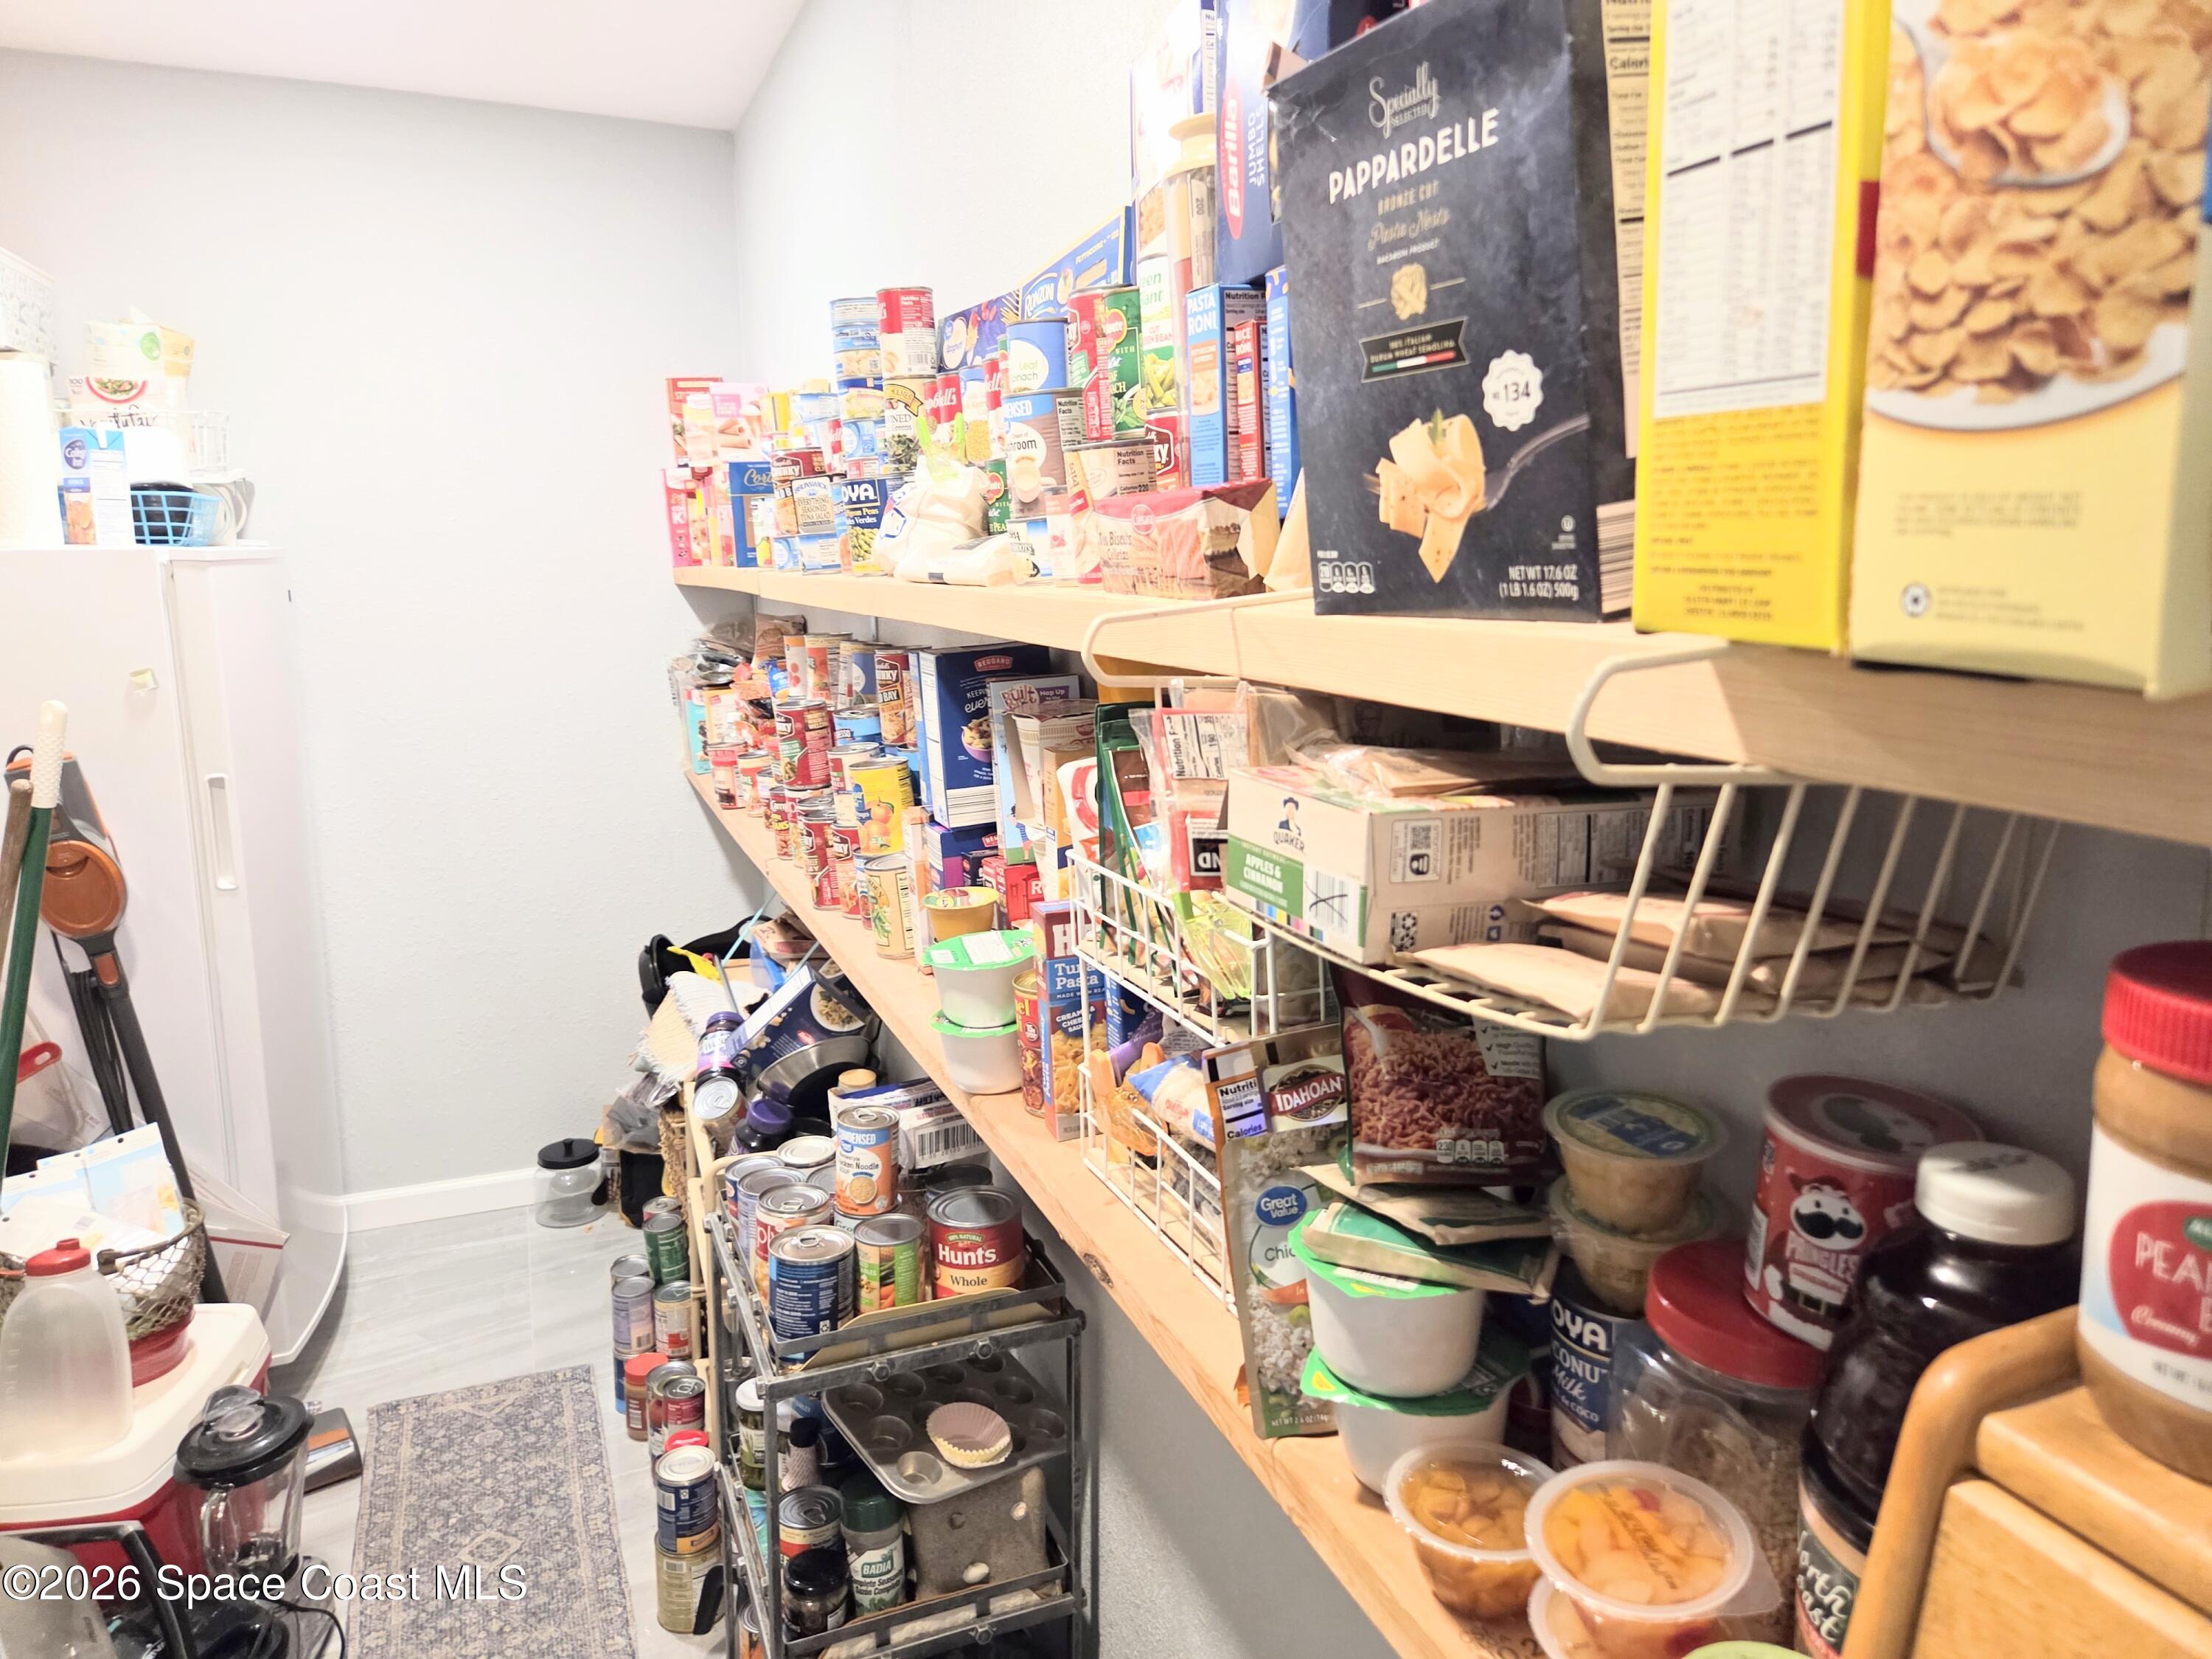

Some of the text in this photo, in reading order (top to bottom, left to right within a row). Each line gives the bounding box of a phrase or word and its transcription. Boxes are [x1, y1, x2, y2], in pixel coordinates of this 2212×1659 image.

[1369, 60, 1441, 139] Specially
[1248, 111, 1259, 185] JUMBO
[1255, 103, 1266, 187] SHELLS
[1224, 98, 1241, 218] Barilla
[1329, 107, 1500, 204] PAPPARDELLE
[1419, 179, 1439, 202] CUT
[1187, 292, 1217, 315] PASTA
[1225, 292, 1259, 300] Nutrition
[1187, 310, 1217, 337] RONI
[1235, 327, 1252, 343] RICE
[1116, 346, 1135, 355] WITH
[1370, 352, 1394, 364] DURUM
[1394, 347, 1417, 359] WHEAT
[1504, 380, 1531, 403] 134
[1116, 450, 1144, 458] Nutrition
[1117, 457, 1135, 465] Facts
[1138, 484, 1150, 493] 220
[797, 498, 830, 507] EVERYTHING
[801, 504, 827, 513] SEASONED
[801, 512, 831, 522] TUNA SALAD
[1508, 564, 1579, 581] NET WT 17.6 OZ
[1509, 582, 1521, 598] LB
[1522, 582, 1536, 598] 1.6
[1536, 582, 1554, 599] OZ)
[1554, 582, 1579, 602] 500g
[884, 689, 899, 703] BAY
[1207, 733, 1217, 747] 190
[1172, 737, 1186, 777] Nutrition
[1273, 831, 1305, 852] QUAKER
[1245, 853, 1282, 879] APPLES &
[1242, 866, 1284, 894] CINNAMON
[1062, 1014, 1092, 1028] CHEEY
[1219, 1079, 1257, 1097] Nutriti
[1275, 1076, 1343, 1112] IDAHOAN
[1222, 1102, 1243, 1112] Serving
[1227, 1123, 1263, 1140] Calories
[855, 1162, 880, 1171] Noodle
[1260, 1193, 1298, 1212] Great
[1270, 1208, 1298, 1219] Value
[959, 1234, 982, 1242] NATURAL
[1264, 1245, 1296, 1262] Chic
[1784, 1229, 1862, 1284] PRINGLES
[950, 1275, 988, 1287] Whole
[1551, 1298, 1610, 1352] OYA
[1554, 1364, 1587, 1401] Milk
[1270, 1417, 1283, 1427] NET
[1283, 1416, 1293, 1425] WT
[1304, 1414, 1313, 1423] OZ
[863, 1559, 892, 1575] BADIA
